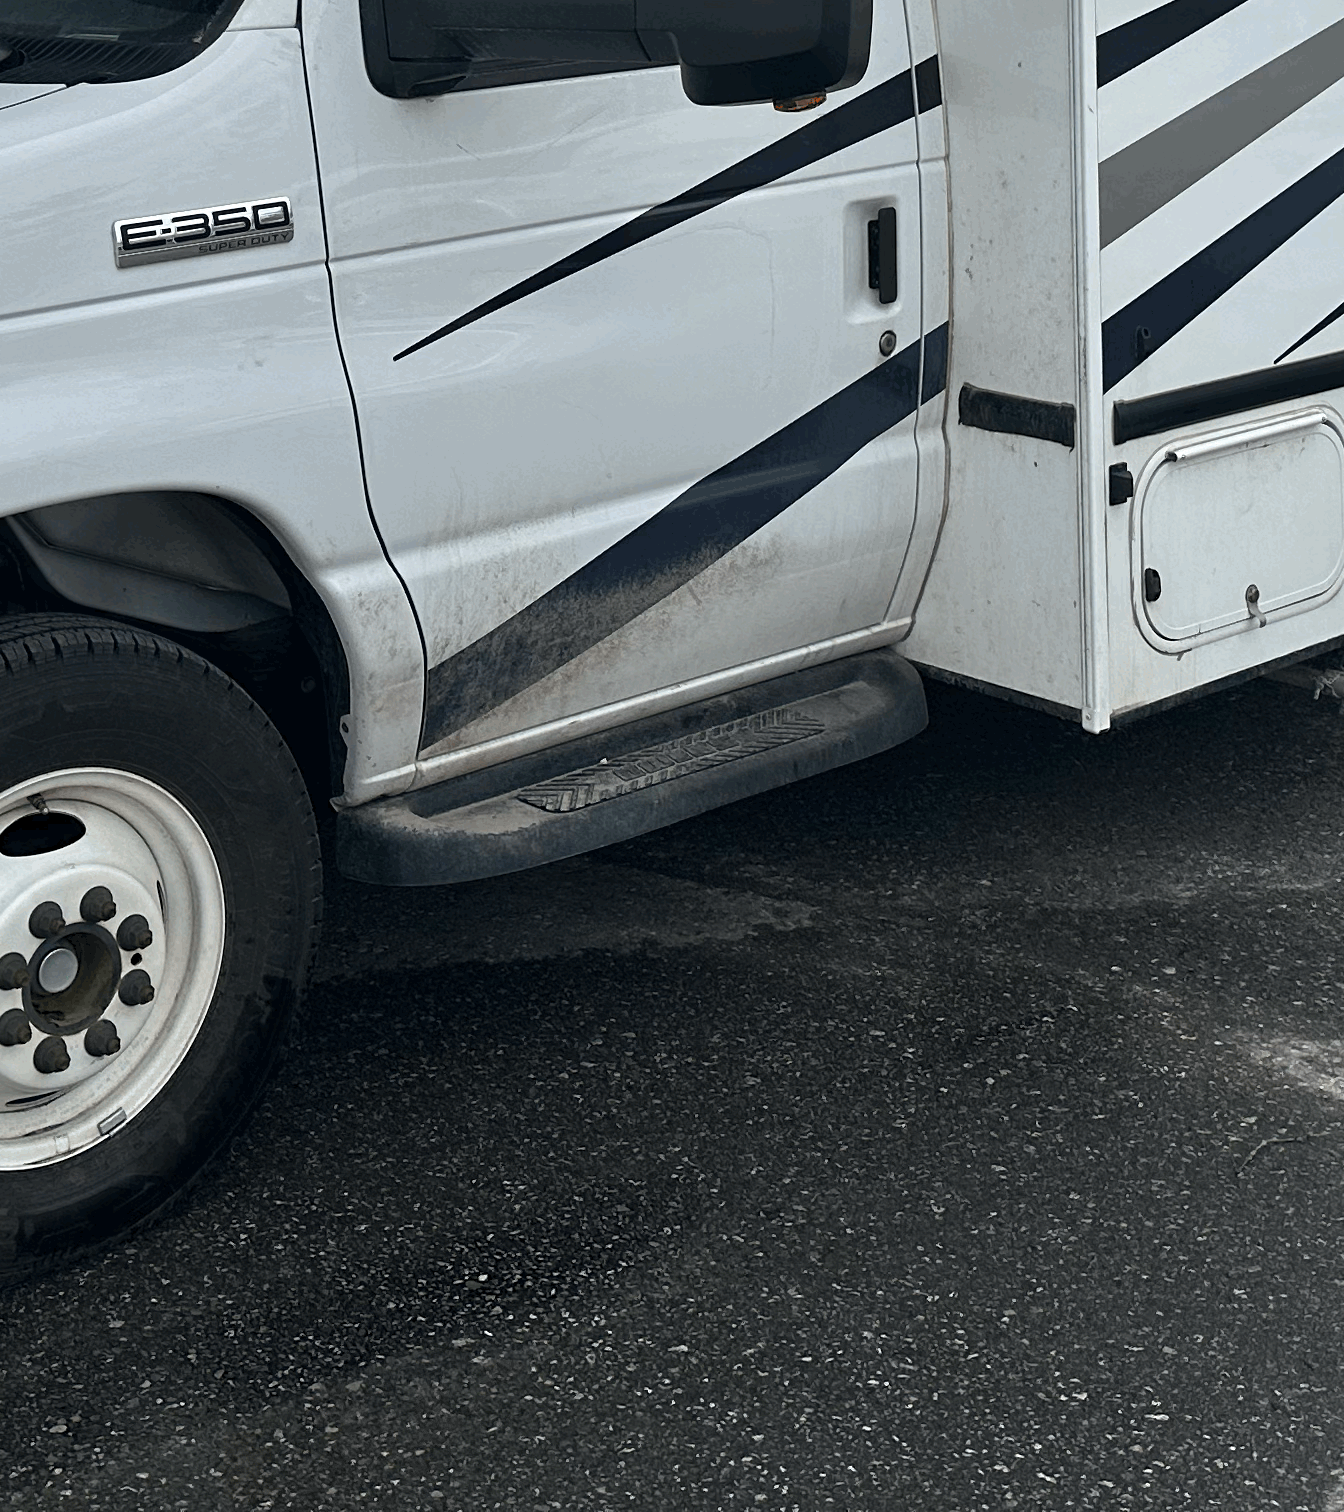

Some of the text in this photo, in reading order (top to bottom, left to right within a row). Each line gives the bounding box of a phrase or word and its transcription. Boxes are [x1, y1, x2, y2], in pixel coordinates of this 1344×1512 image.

[120, 201, 291, 251] E-350
[199, 232, 290, 253] SUPER DUTY
